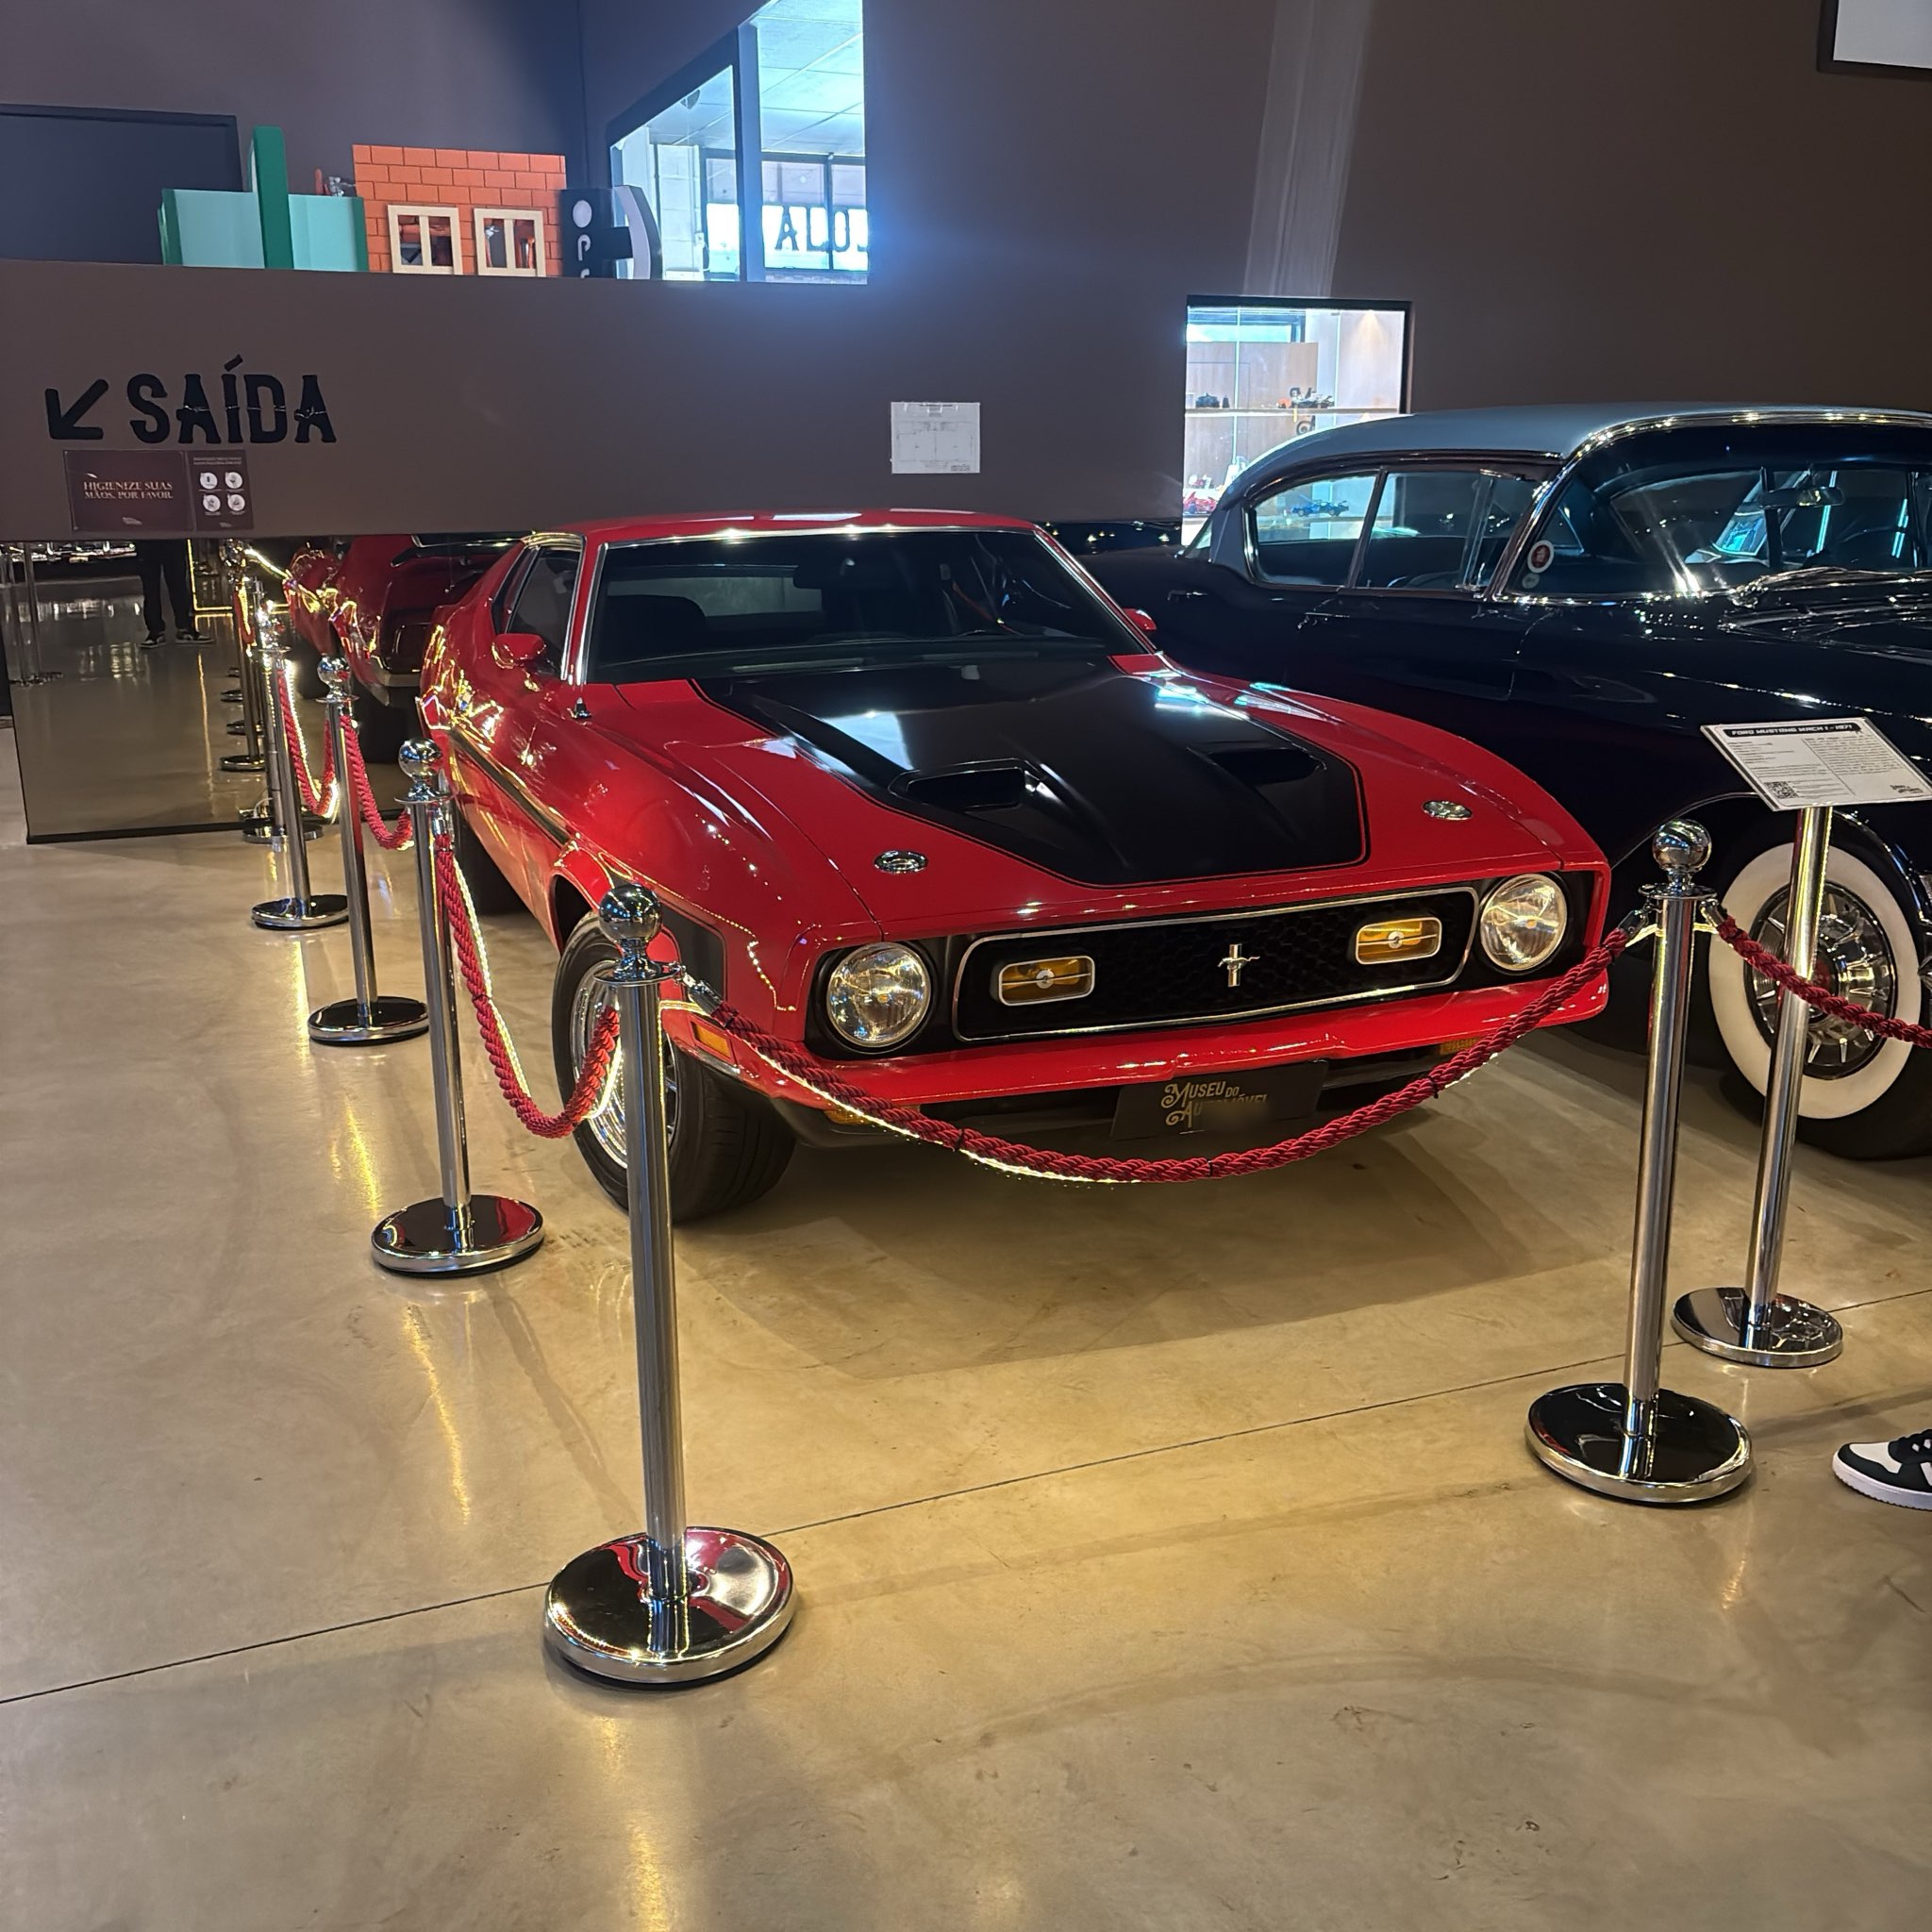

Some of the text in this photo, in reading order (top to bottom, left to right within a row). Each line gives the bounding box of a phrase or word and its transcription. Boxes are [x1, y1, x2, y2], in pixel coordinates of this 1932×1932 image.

[126, 354, 337, 444] SAÍDA
[83, 481, 173, 491] HIGIENIZE SUAS
[118, 491, 139, 499] POR
[1160, 1081, 1241, 1108] MUSEU DO
